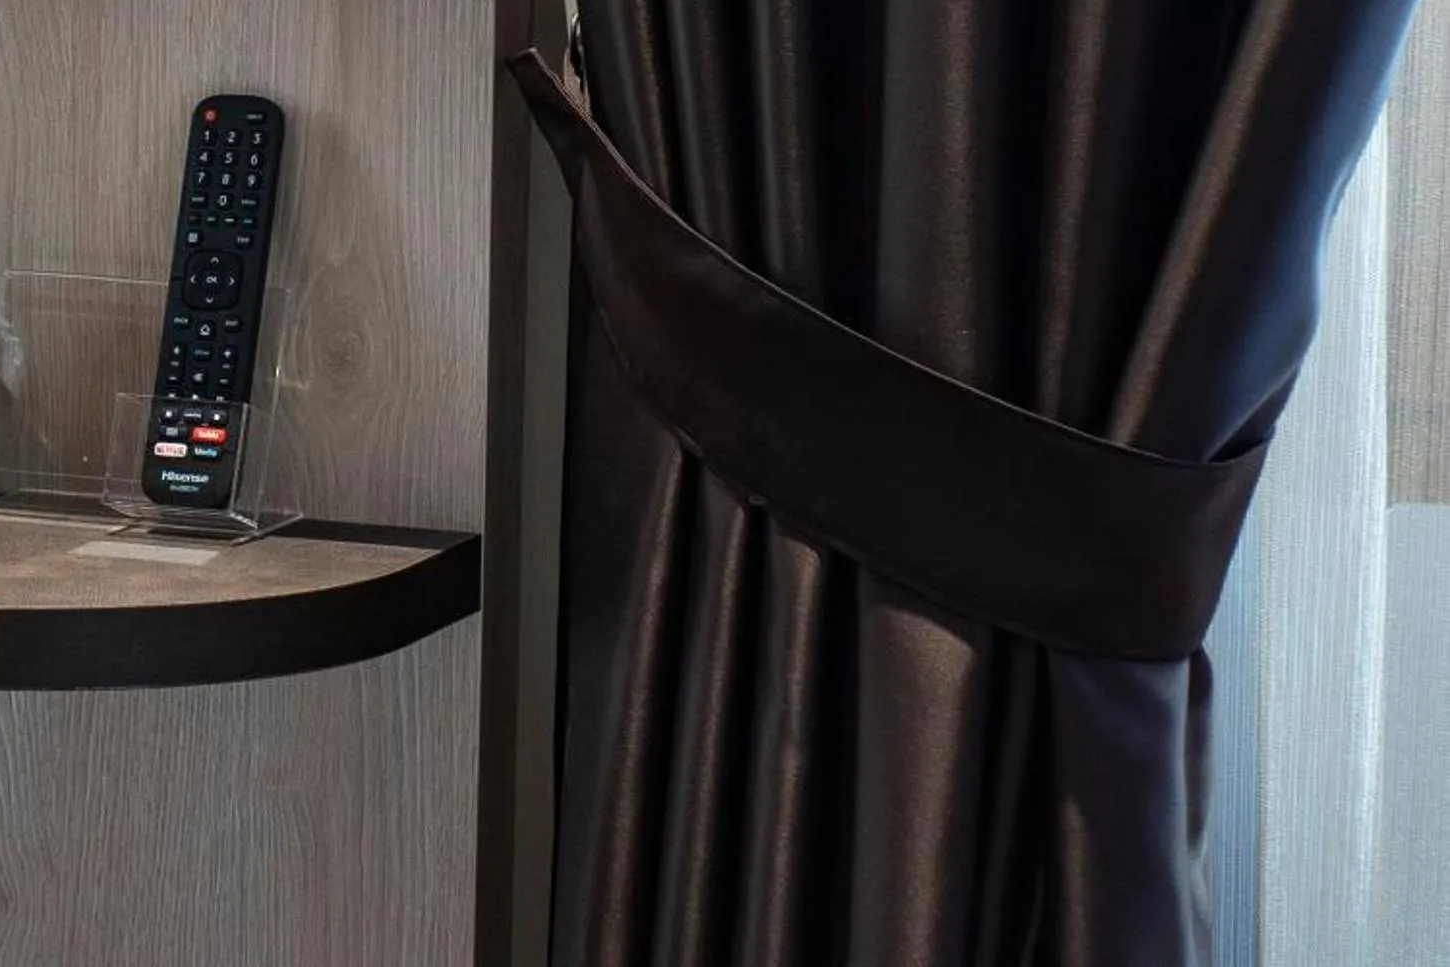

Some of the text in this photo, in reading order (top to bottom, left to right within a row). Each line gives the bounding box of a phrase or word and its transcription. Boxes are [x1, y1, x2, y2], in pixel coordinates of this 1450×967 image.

[204, 131, 210, 141] 1
[227, 132, 235, 142] 2
[253, 133, 261, 144] 3
[199, 152, 208, 162] 4
[225, 153, 233, 163] 5
[251, 154, 259, 165] 6
[198, 172, 205, 183] 7
[222, 174, 230, 184] 8
[248, 175, 255, 186] 9
[161, 470, 210, 483] Hisense
